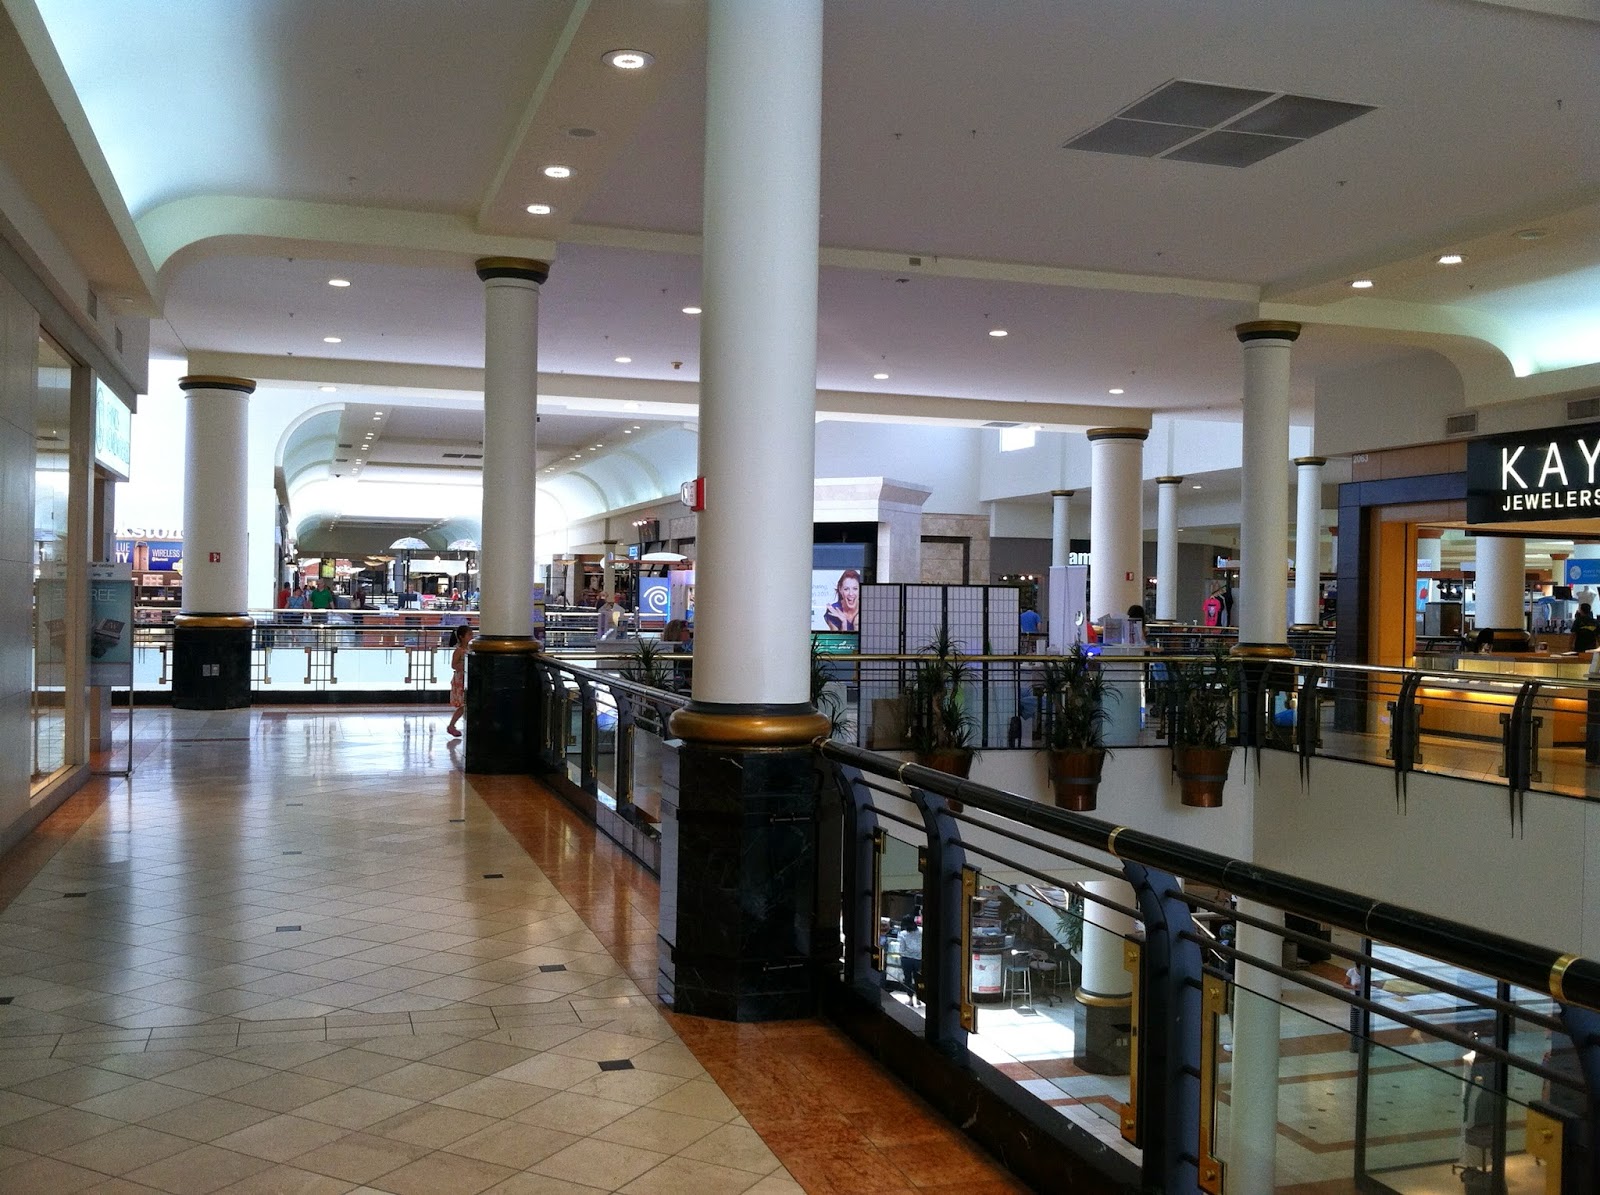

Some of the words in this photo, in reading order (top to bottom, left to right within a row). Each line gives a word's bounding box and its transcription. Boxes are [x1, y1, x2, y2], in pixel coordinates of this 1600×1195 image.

[1501, 438, 1600, 491] KAY
[1502, 488, 1600, 511] JEWELERS
[151, 549, 181, 558] WIRELESS
